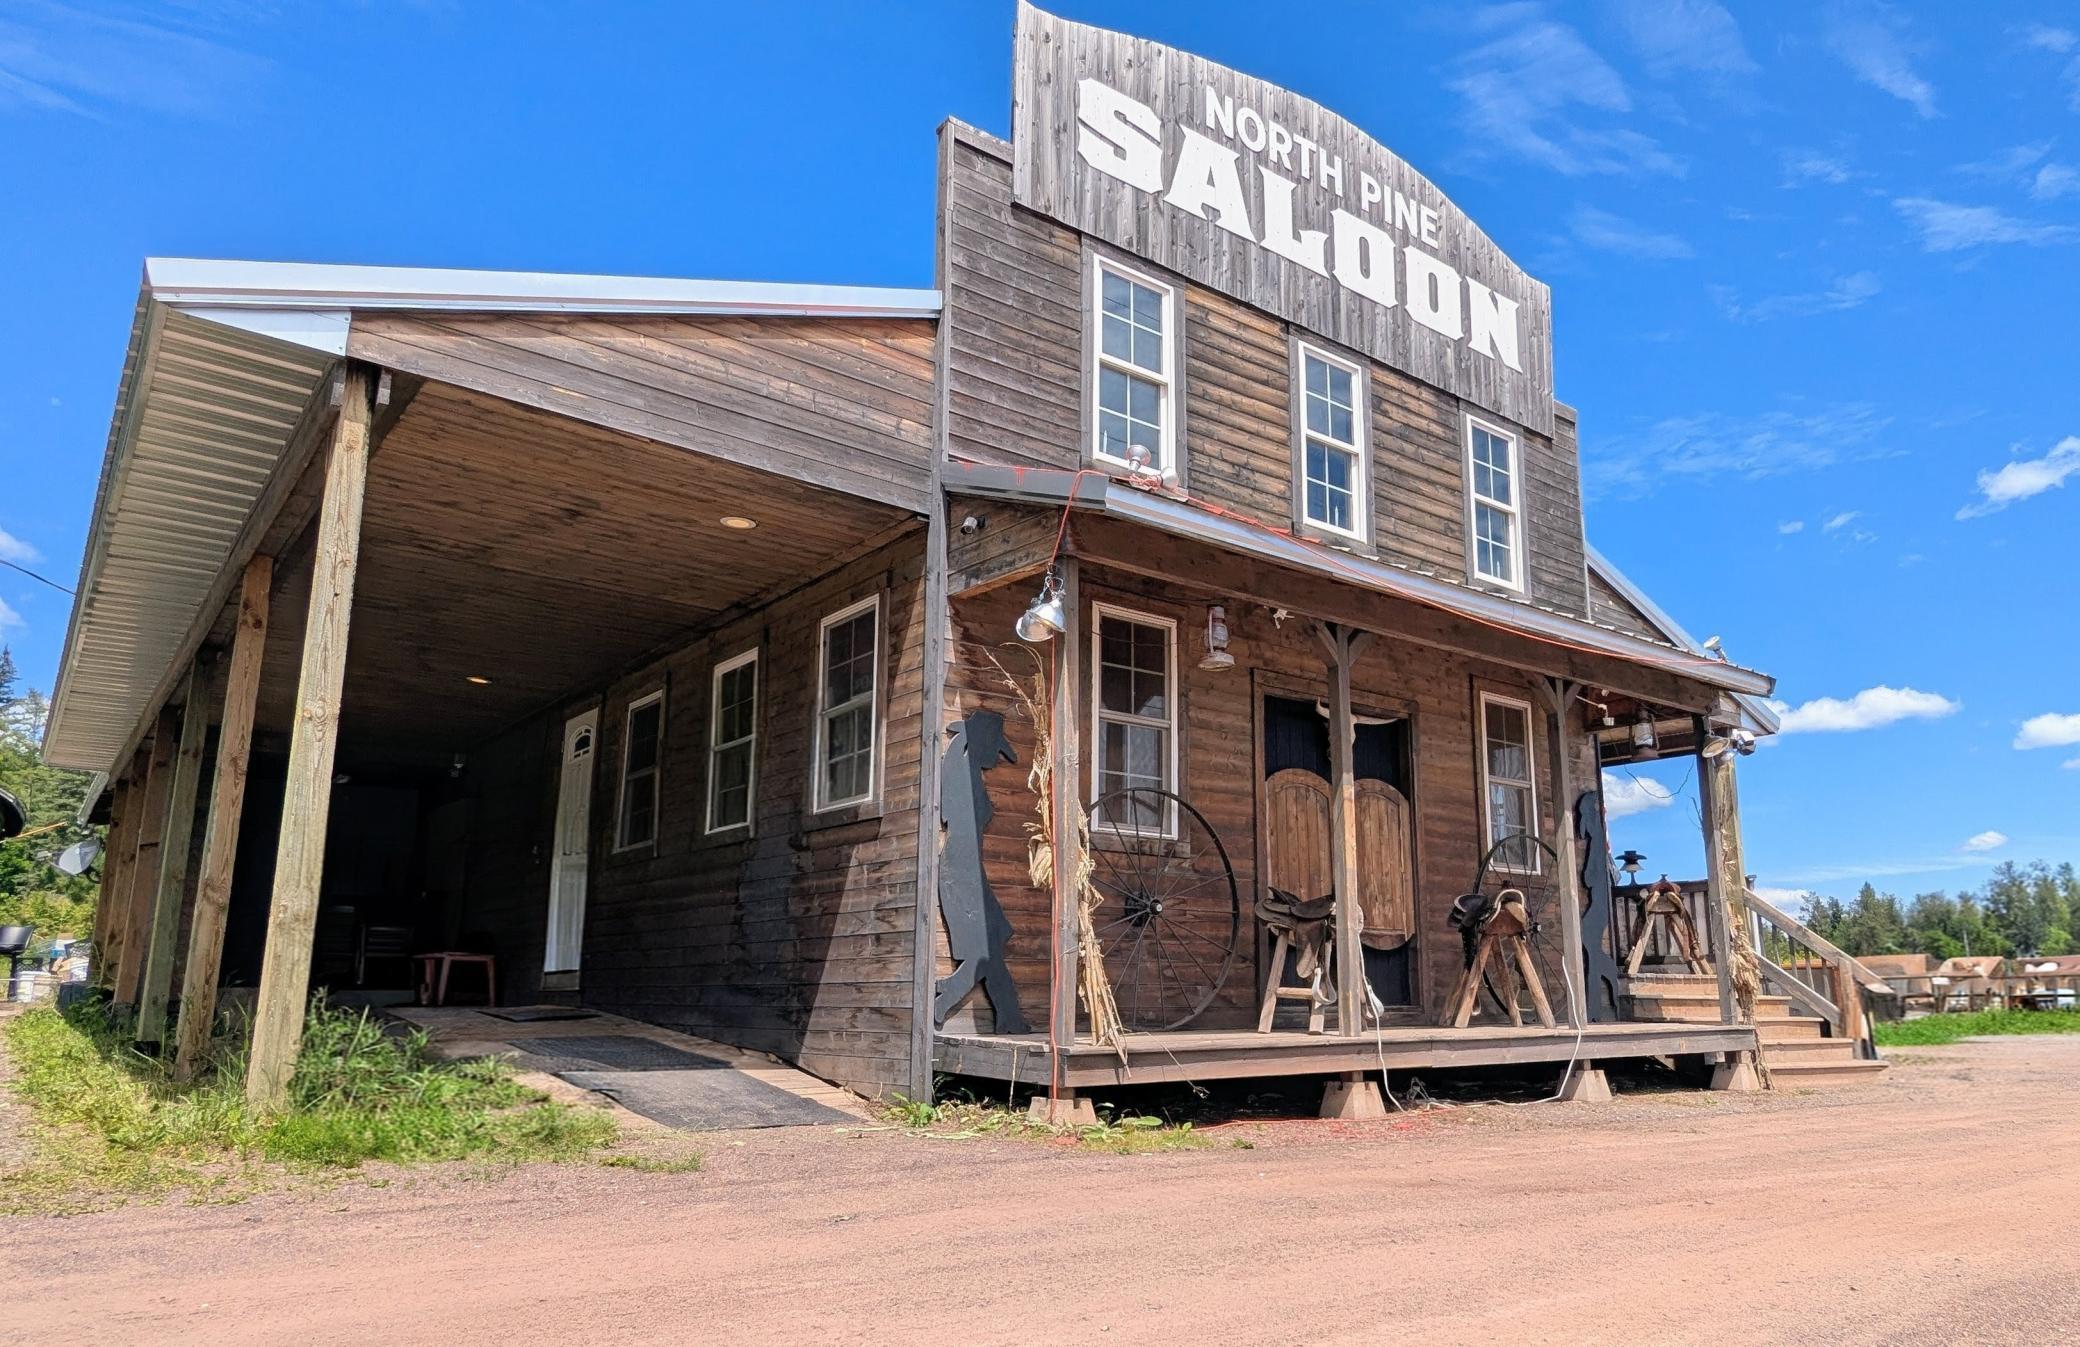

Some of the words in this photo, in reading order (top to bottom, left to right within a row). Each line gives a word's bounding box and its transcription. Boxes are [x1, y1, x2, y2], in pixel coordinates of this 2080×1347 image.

[1076, 76, 1524, 373] SALOON
[1204, 84, 1344, 197] NORTH
[1360, 170, 1440, 250] PINE
